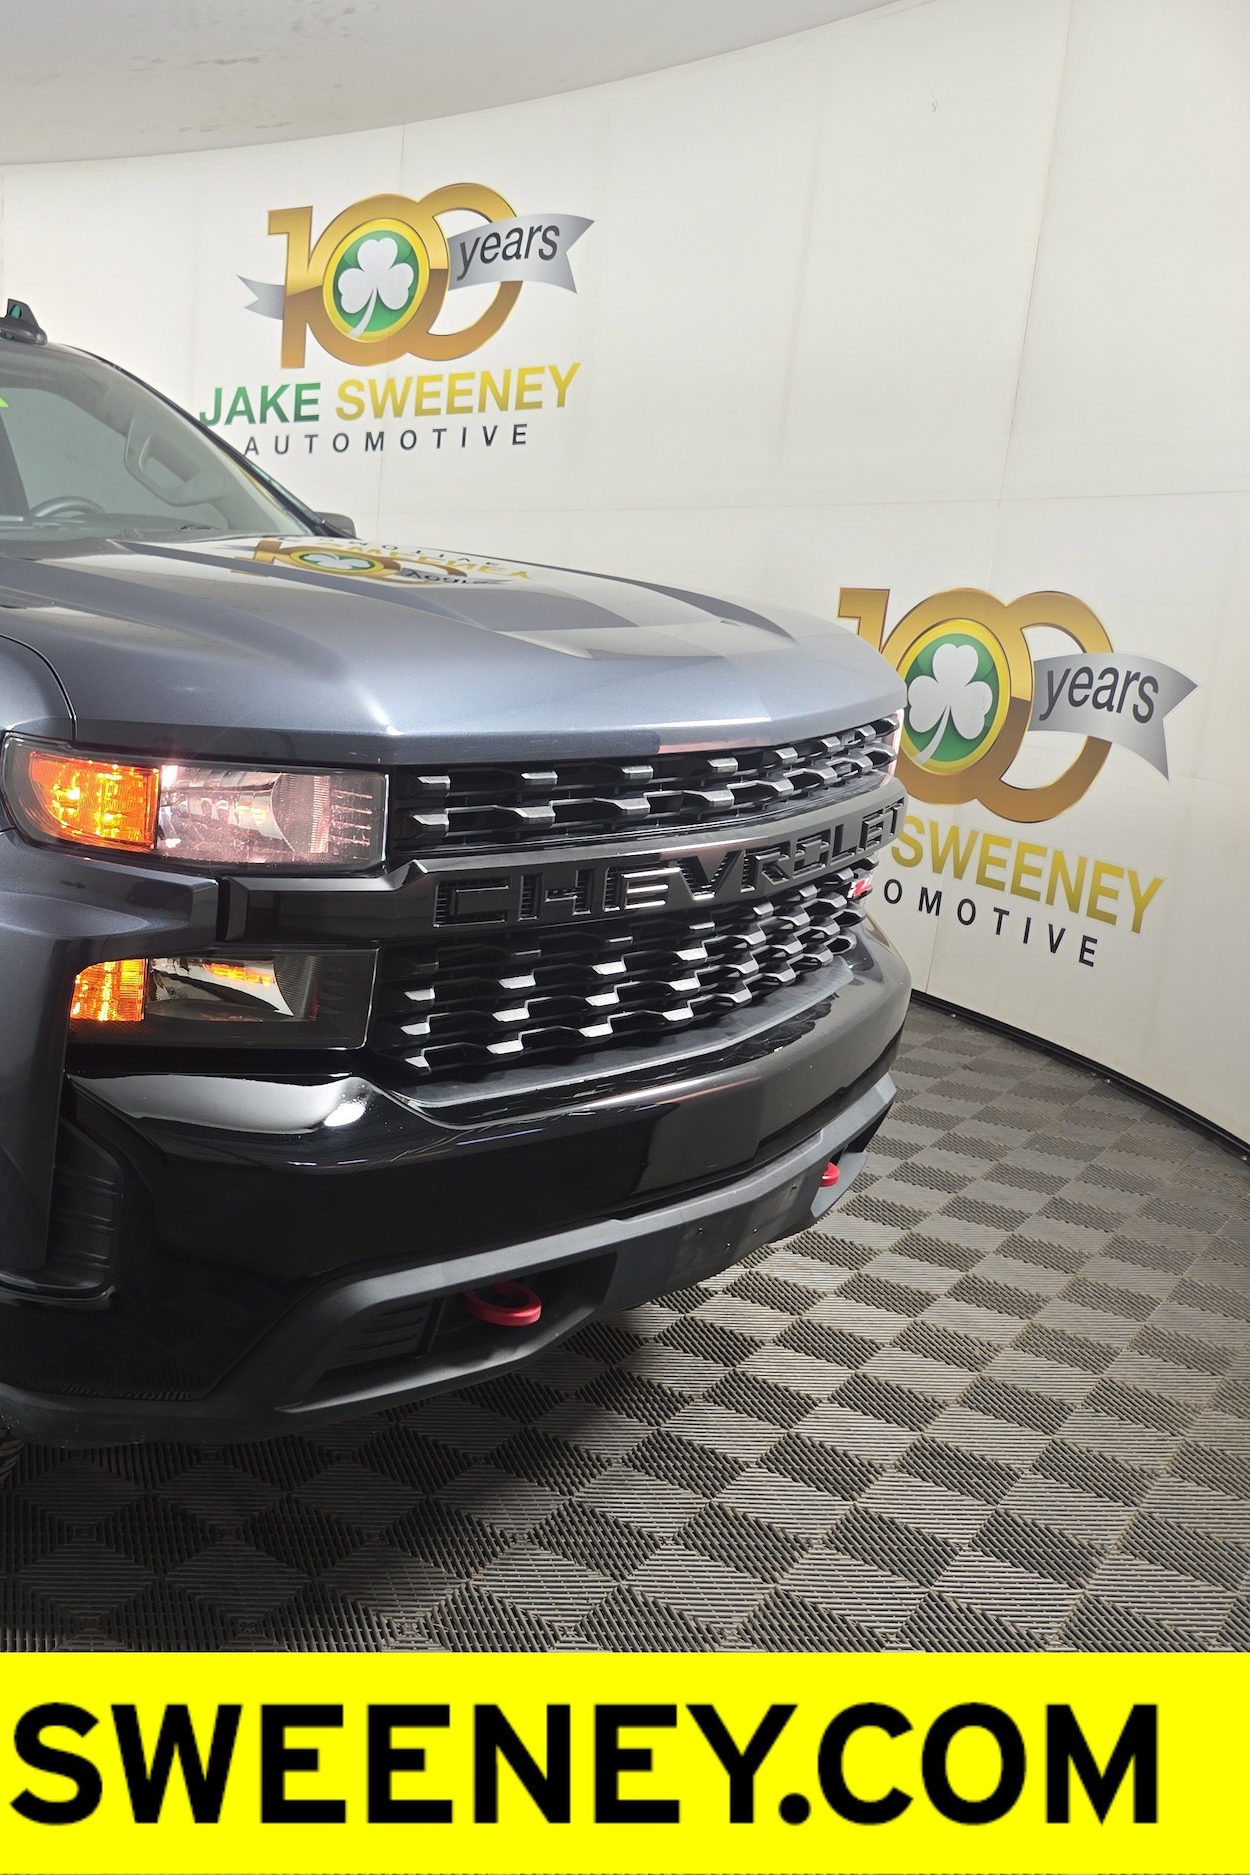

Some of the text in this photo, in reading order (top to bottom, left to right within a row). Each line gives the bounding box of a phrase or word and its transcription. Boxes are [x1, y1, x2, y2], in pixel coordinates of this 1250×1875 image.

[456, 224, 561, 281] years
[199, 362, 581, 427] JAKE SWEENEY
[244, 423, 528, 457] AUTOMOTIVE
[1039, 666, 1160, 724] years
[434, 797, 905, 928] CHEVROLET
[891, 814, 1164, 935] SWEENEY
[883, 878, 1099, 968] OMOTIVE
